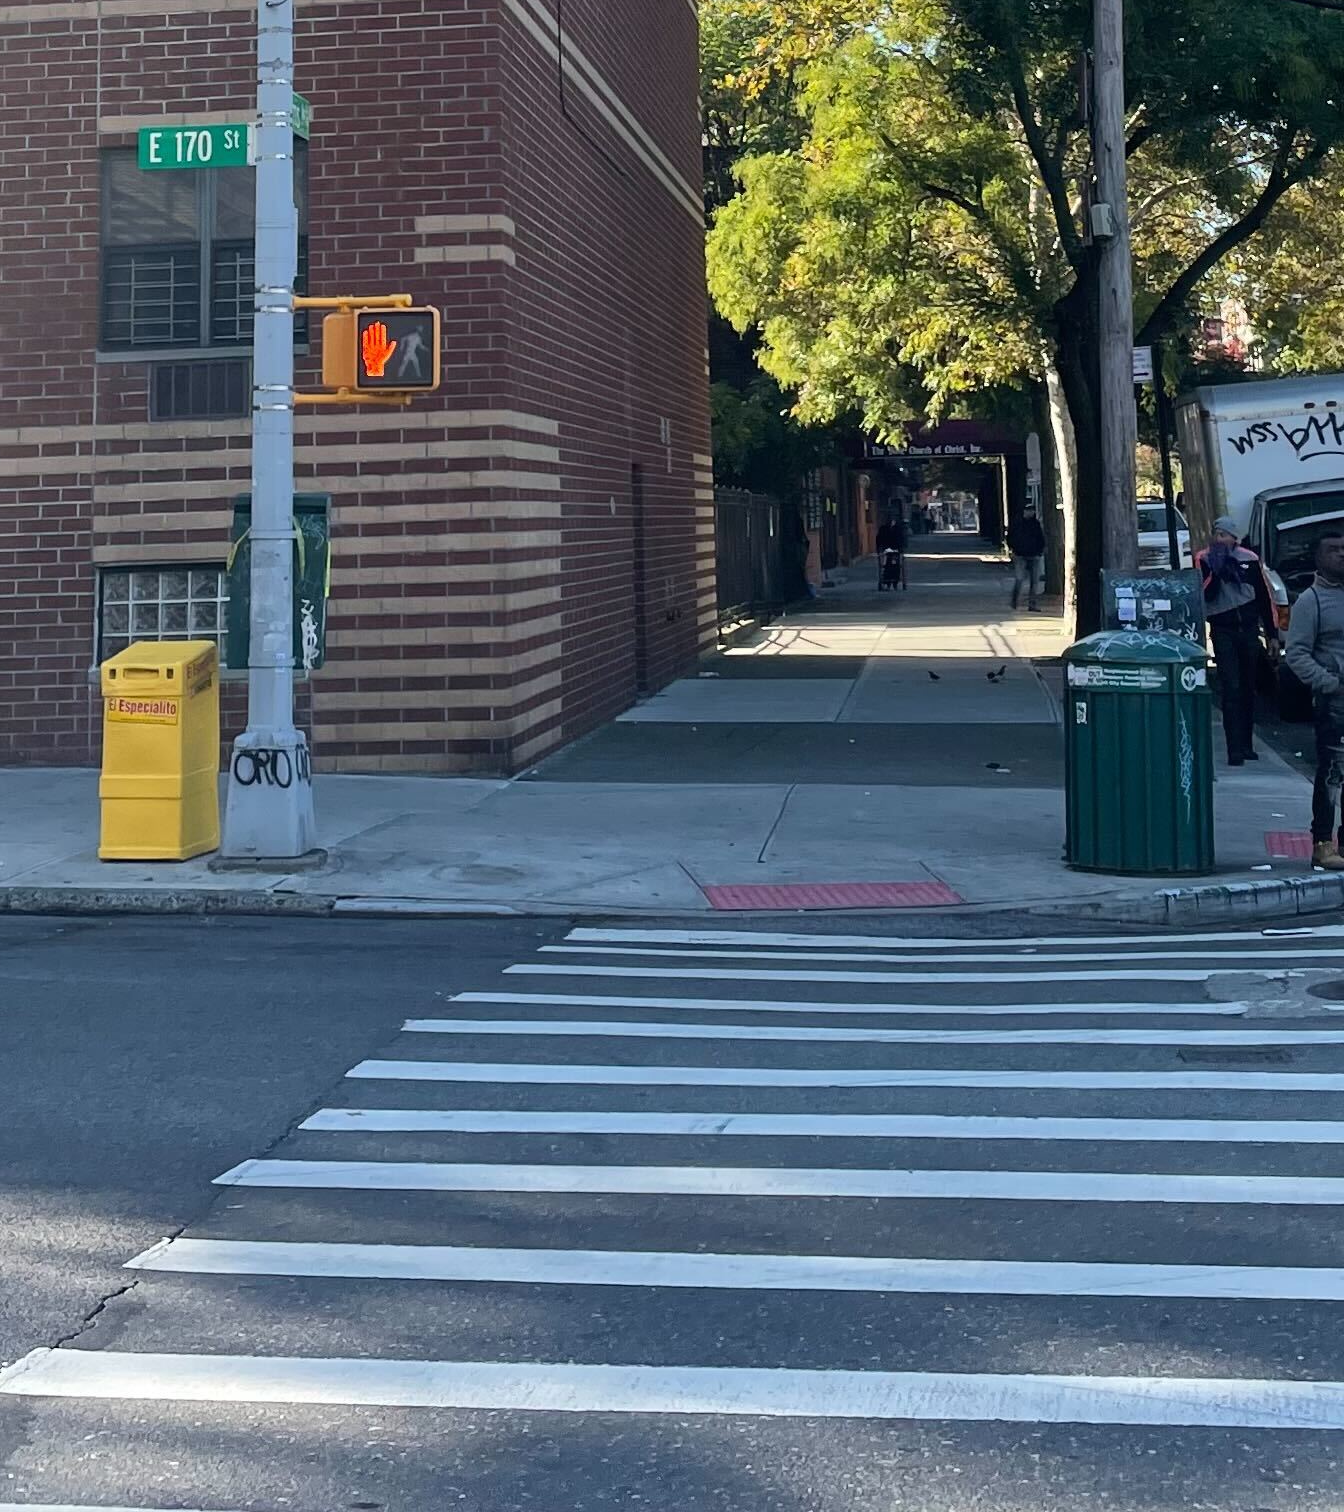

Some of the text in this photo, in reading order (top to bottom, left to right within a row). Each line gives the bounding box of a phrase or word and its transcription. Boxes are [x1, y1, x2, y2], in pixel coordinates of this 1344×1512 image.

[150, 130, 239, 163] E 170 St
[119, 699, 176, 715] Especialito
